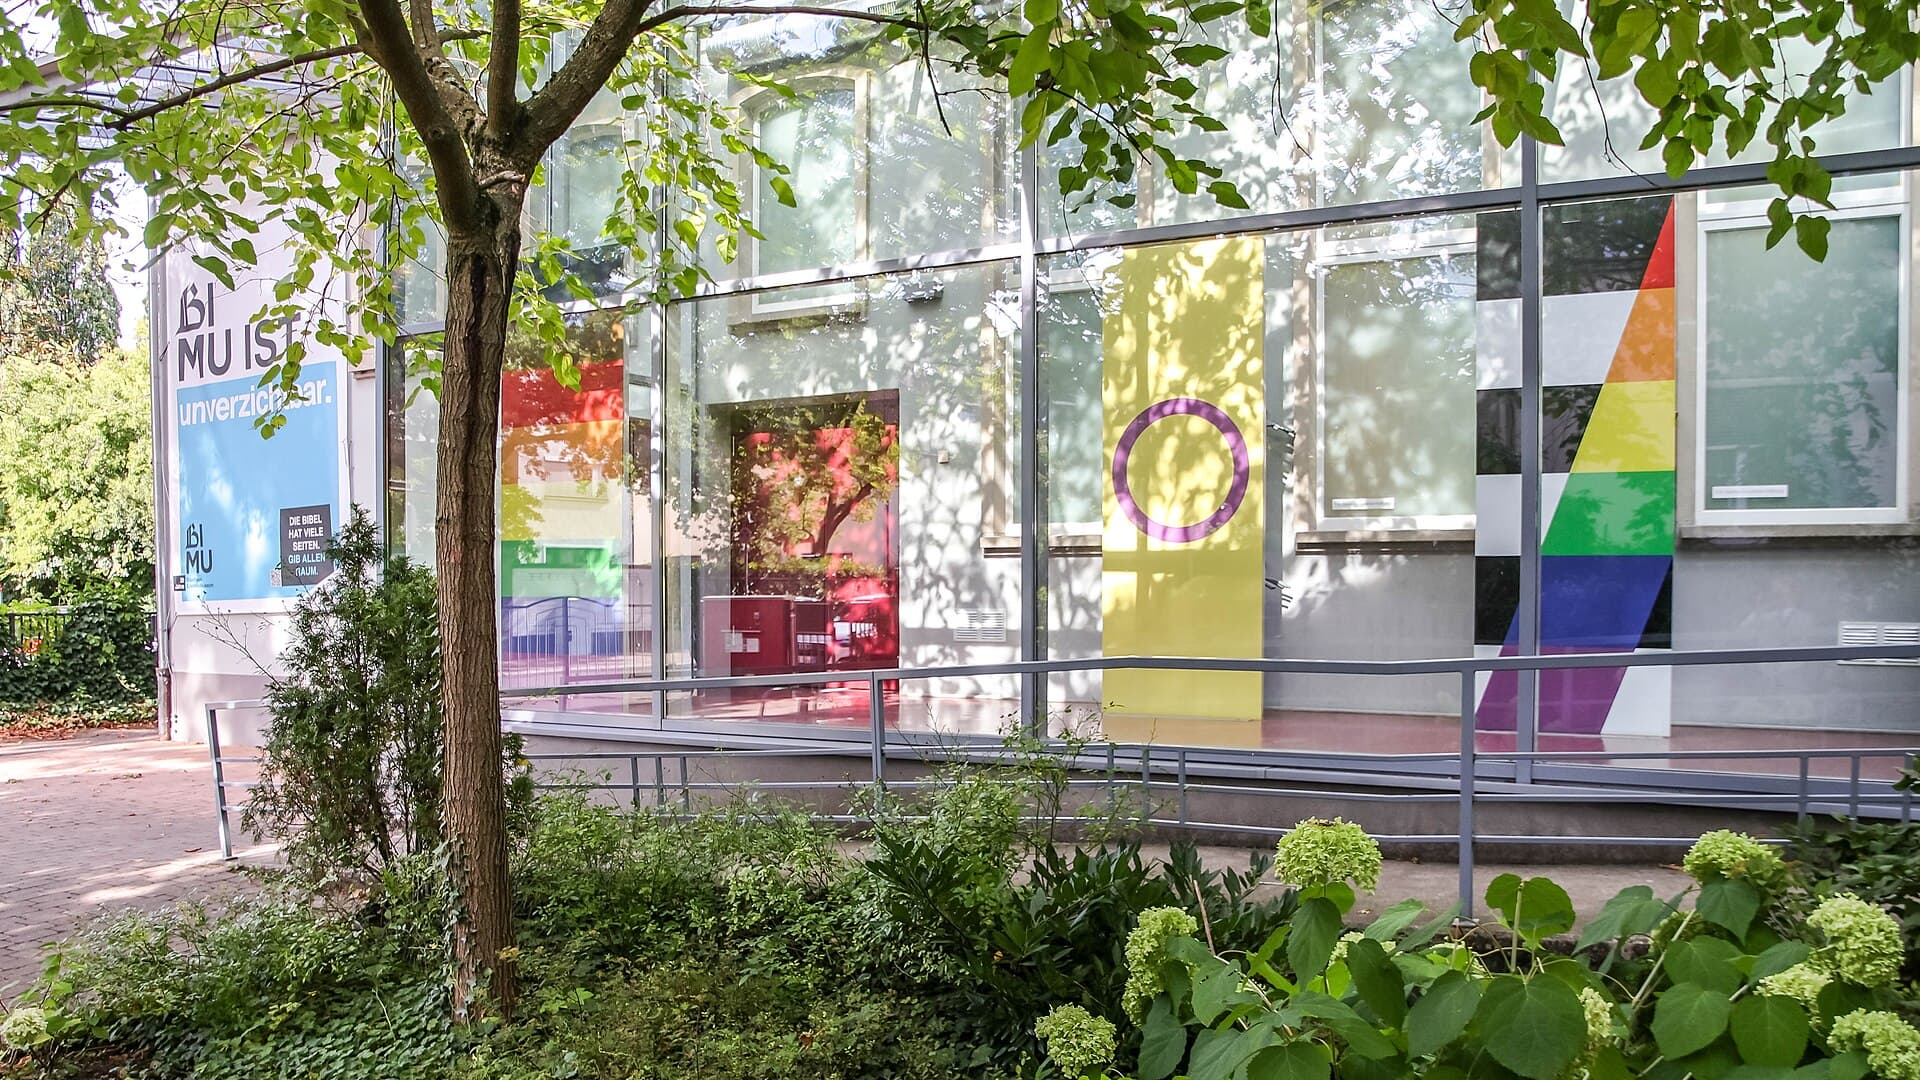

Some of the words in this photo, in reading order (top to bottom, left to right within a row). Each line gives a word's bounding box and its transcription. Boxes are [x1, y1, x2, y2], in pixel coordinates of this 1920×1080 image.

[178, 328, 232, 382] MU
[244, 312, 302, 371] IST
[289, 516, 301, 526] DIE
[302, 514, 322, 525] BIBEL
[288, 529, 302, 539] HAT
[303, 527, 324, 538] VIELE
[292, 540, 320, 551] SEITEN.
[186, 549, 213, 574] MU
[288, 554, 301, 564] GIB
[302, 552, 326, 563] ALLEN
